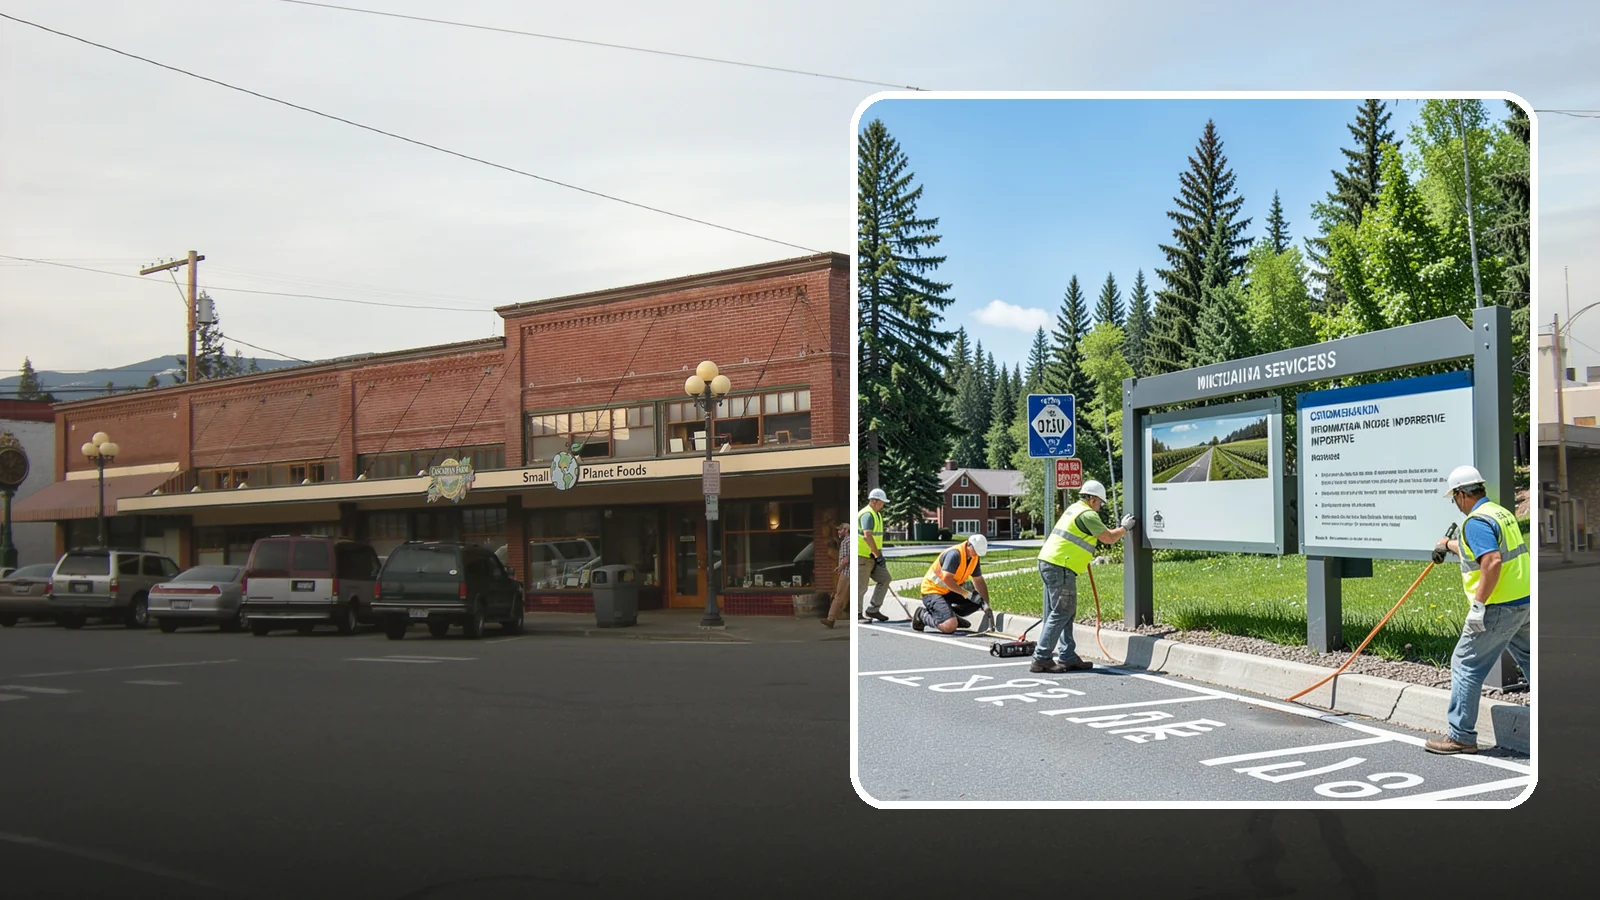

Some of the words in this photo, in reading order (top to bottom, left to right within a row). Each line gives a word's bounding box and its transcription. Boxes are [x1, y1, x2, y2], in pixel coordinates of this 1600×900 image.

[523, 470, 549, 483] Small
[583, 467, 614, 479] Planet
[617, 464, 647, 477] Foods
